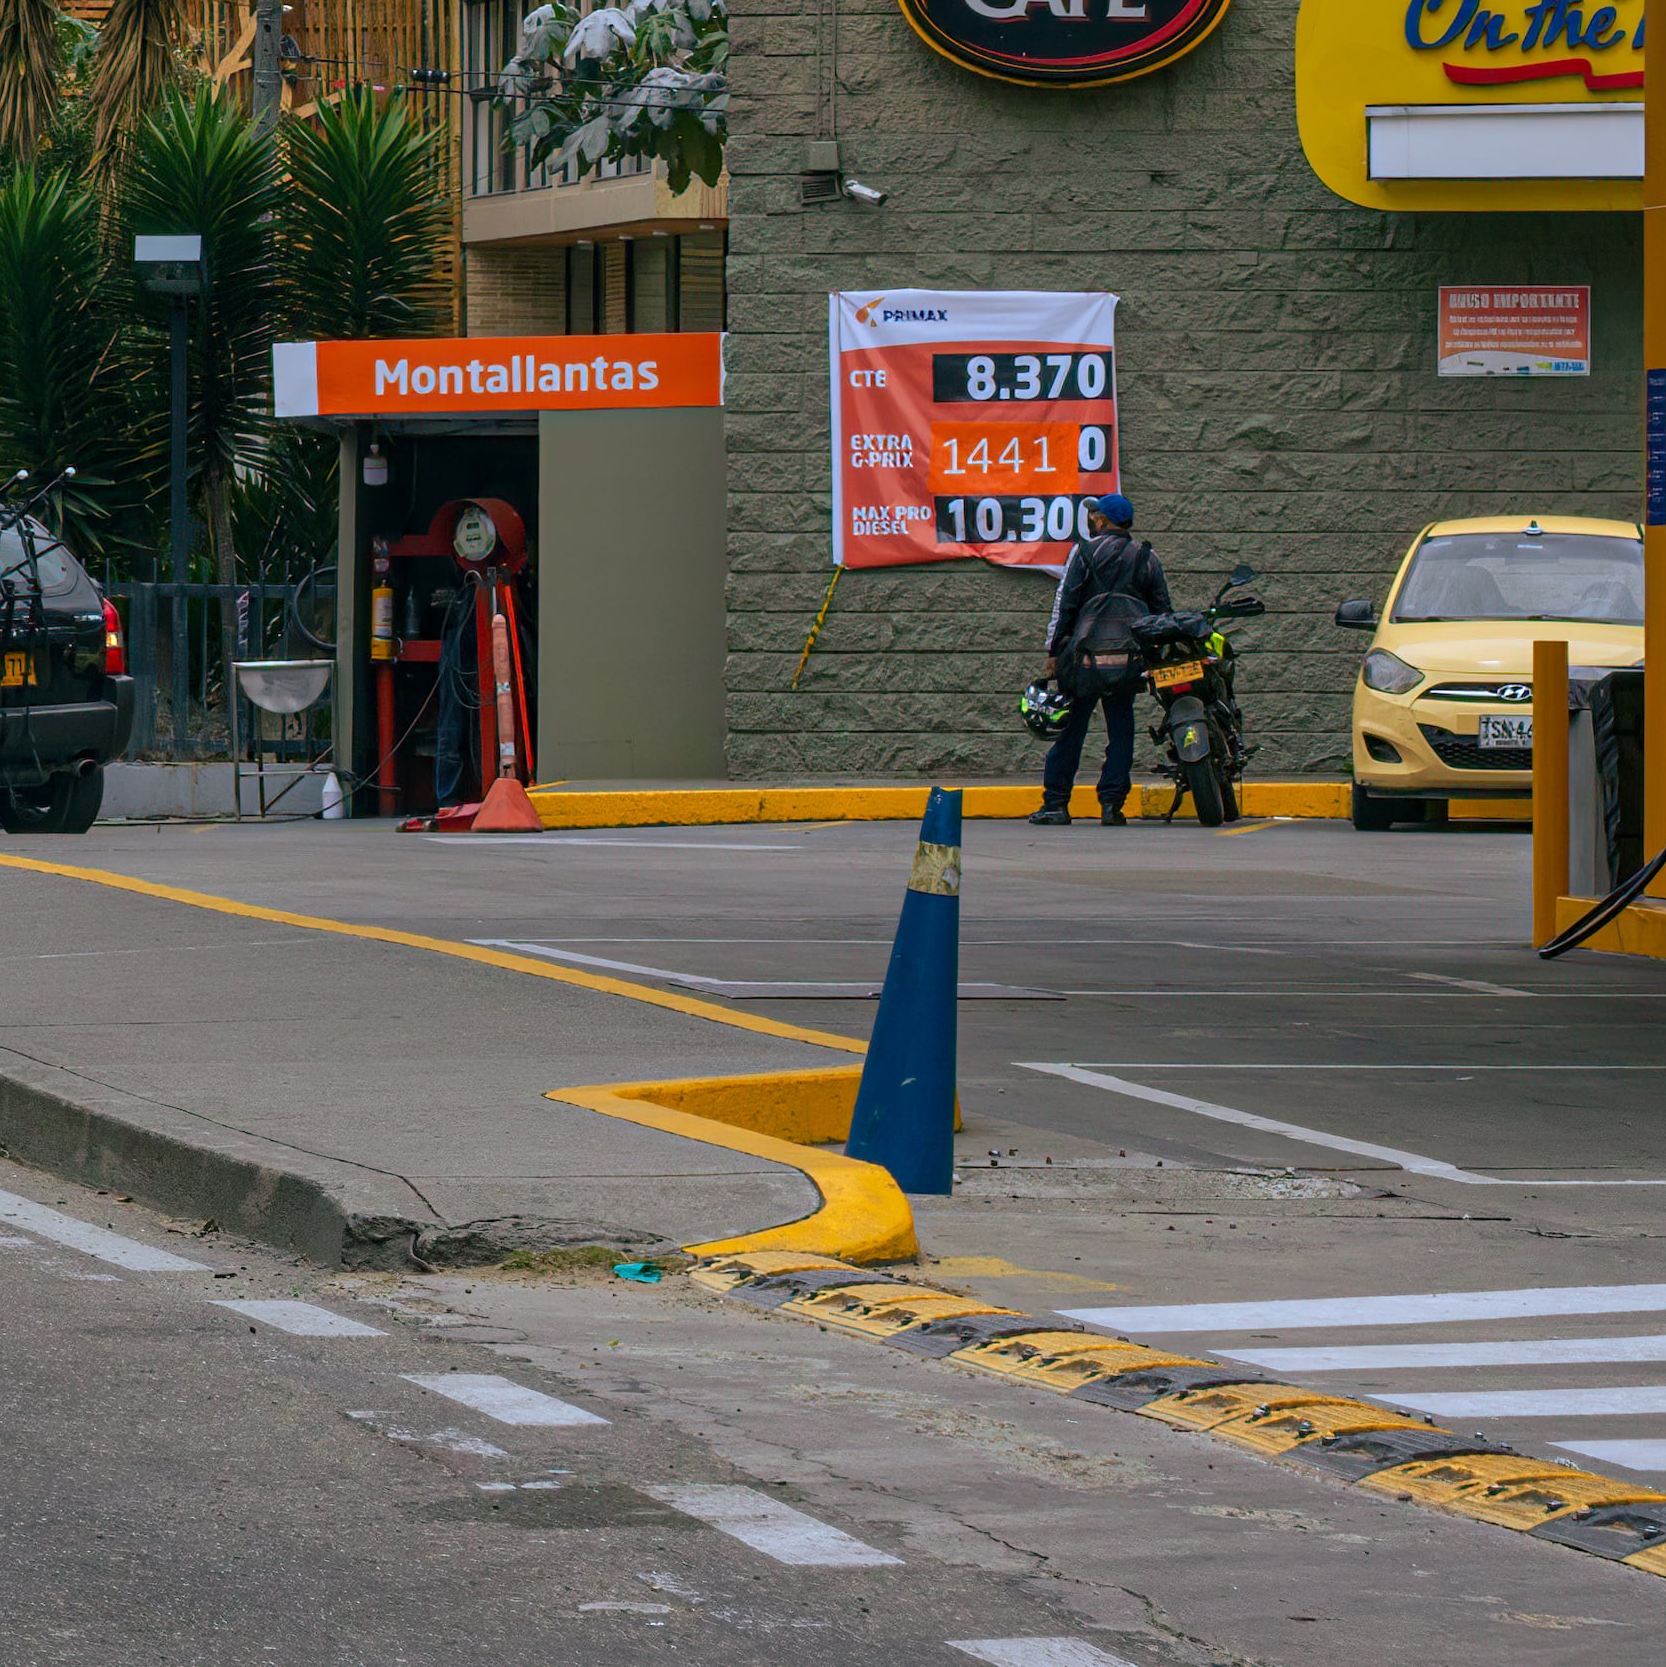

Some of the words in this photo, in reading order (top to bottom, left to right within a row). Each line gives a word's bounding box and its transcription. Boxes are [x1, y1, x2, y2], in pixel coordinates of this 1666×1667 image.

[883, 309, 948, 323] PRIMAX
[374, 354, 660, 398] Montallantas
[849, 370, 887, 389] CTE
[966, 353, 1107, 401] 8.370
[850, 434, 913, 451] EXTRA
[895, 505, 932, 521] PRO
[852, 520, 910, 536] DIESEL
